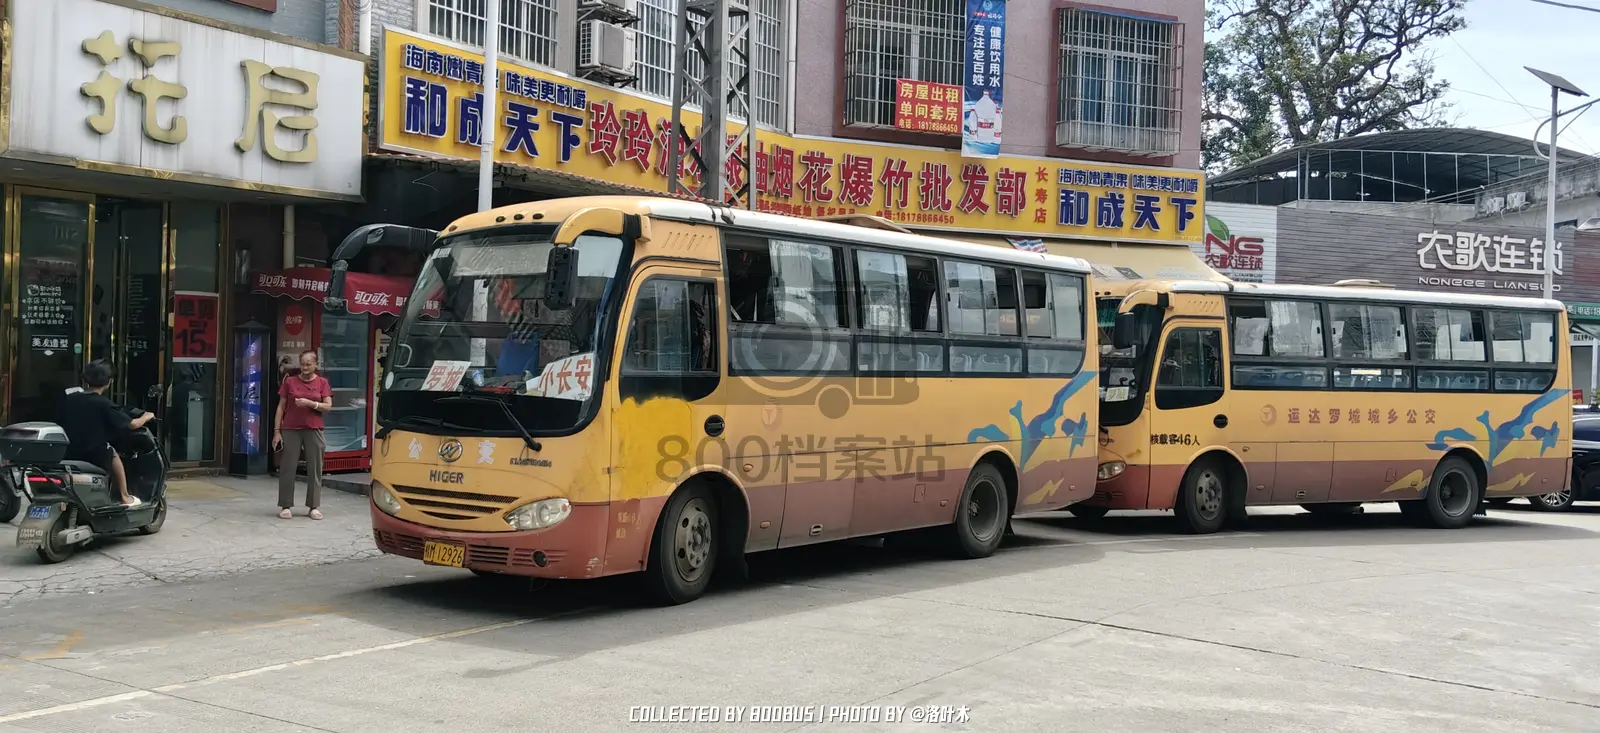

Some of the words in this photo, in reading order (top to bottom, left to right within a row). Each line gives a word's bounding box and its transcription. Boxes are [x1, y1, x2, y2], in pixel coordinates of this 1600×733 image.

[973, 24, 985, 86] 专注老百姓
[989, 26, 1002, 87] 健康饮用水
[405, 44, 499, 88] 海南嫩青
[506, 71, 587, 110] 味美更耐嚼
[80, 29, 320, 163] 托尼
[900, 82, 959, 104] 房屋出租
[899, 101, 959, 122] 单间套房
[1059, 168, 1128, 189] 海南嫩青果
[1034, 166, 1048, 224] 长寿店
[1058, 188, 1197, 233] 和成天下
[1205, 232, 1264, 256] NG
[1416, 229, 1563, 276] 农歌连锁
[1205, 253, 1264, 271] 农歌连锁
[258, 273, 287, 289] 可口可乐
[354, 290, 393, 307] 可口可乐
[423, 363, 465, 392] 罗城
[1287, 408, 1436, 425] 运达罗城城乡公交
[429, 469, 465, 485] HIGER
